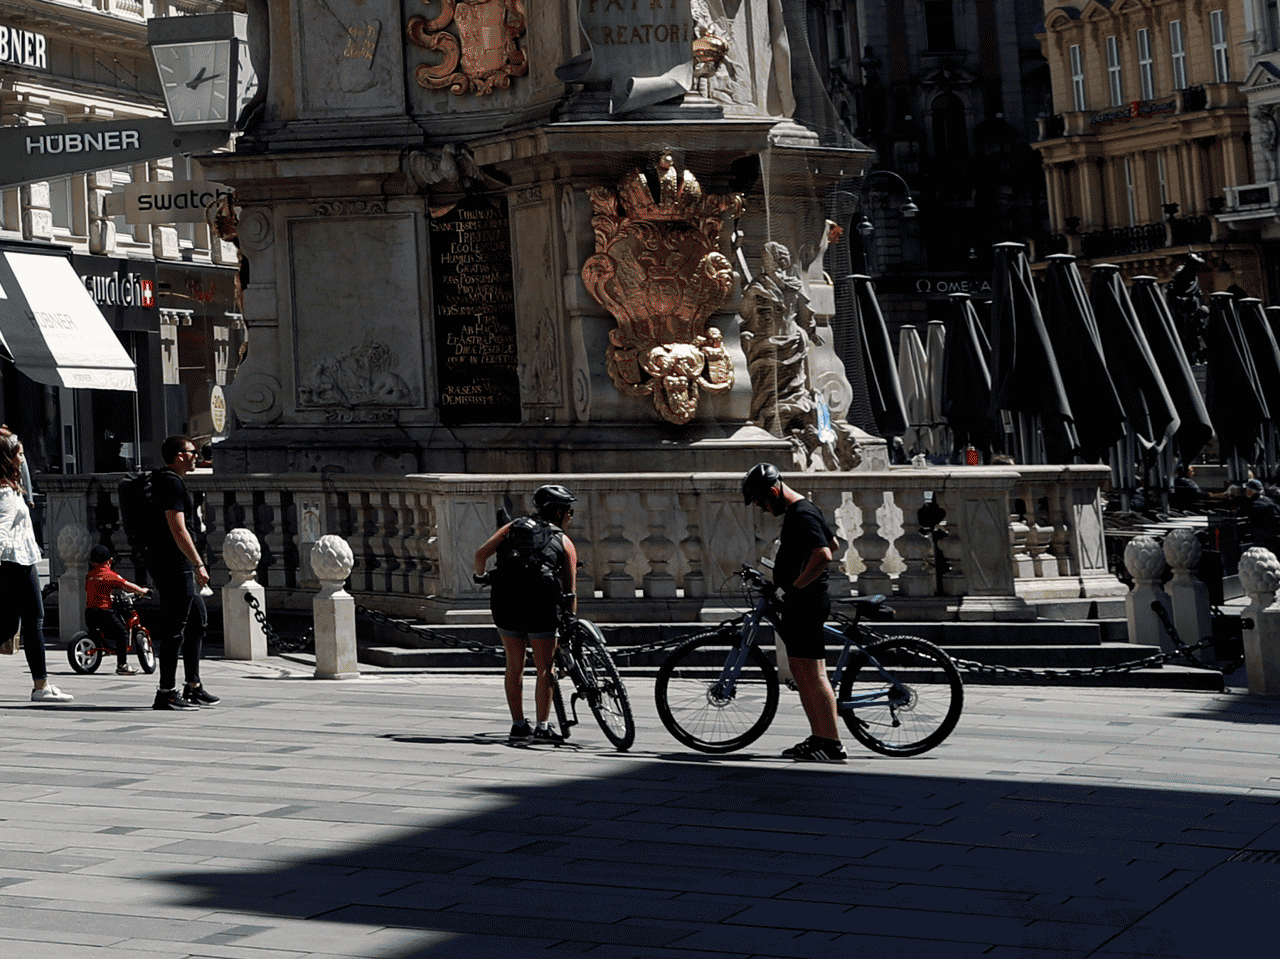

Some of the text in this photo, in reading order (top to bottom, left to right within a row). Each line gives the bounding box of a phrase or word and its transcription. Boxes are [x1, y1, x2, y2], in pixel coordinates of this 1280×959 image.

[587, 23, 689, 46] CREATORI
[26, 130, 140, 155] HÜBNER
[138, 189, 228, 211] swatch
